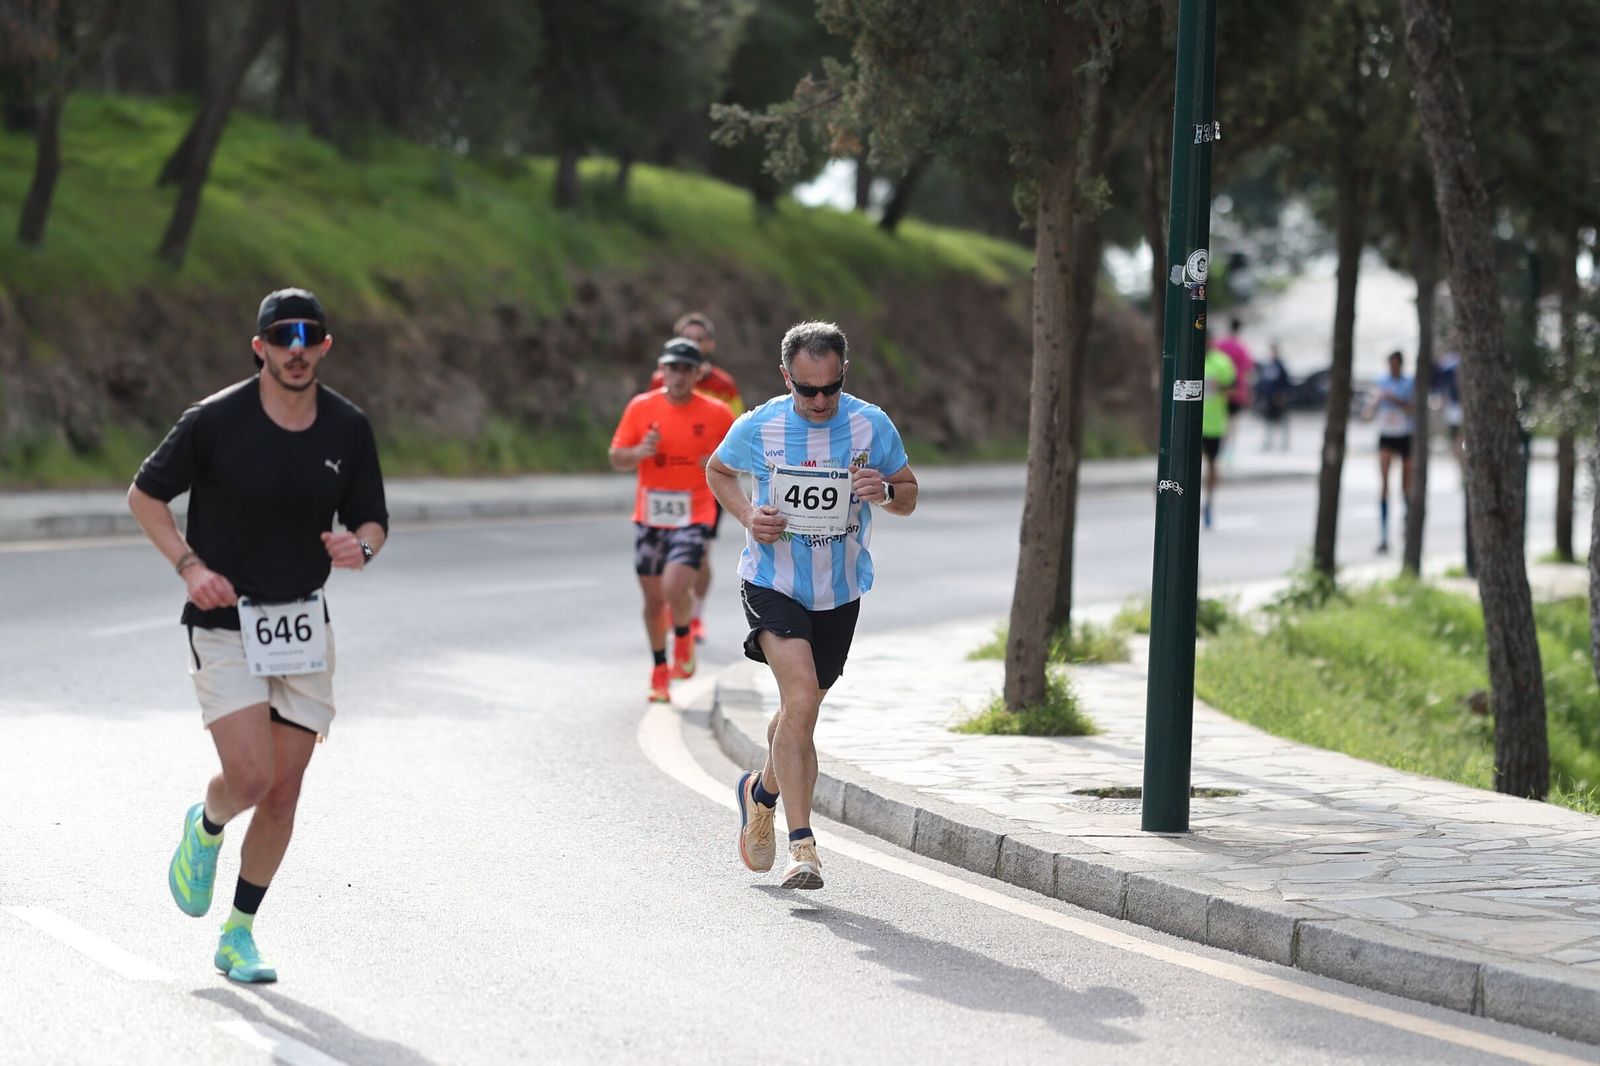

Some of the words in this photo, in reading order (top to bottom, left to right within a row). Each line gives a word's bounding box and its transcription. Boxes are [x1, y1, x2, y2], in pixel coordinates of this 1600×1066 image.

[765, 449, 784, 457] vive
[784, 485, 838, 510] 469
[653, 500, 685, 517] 343
[256, 613, 312, 645] 646
